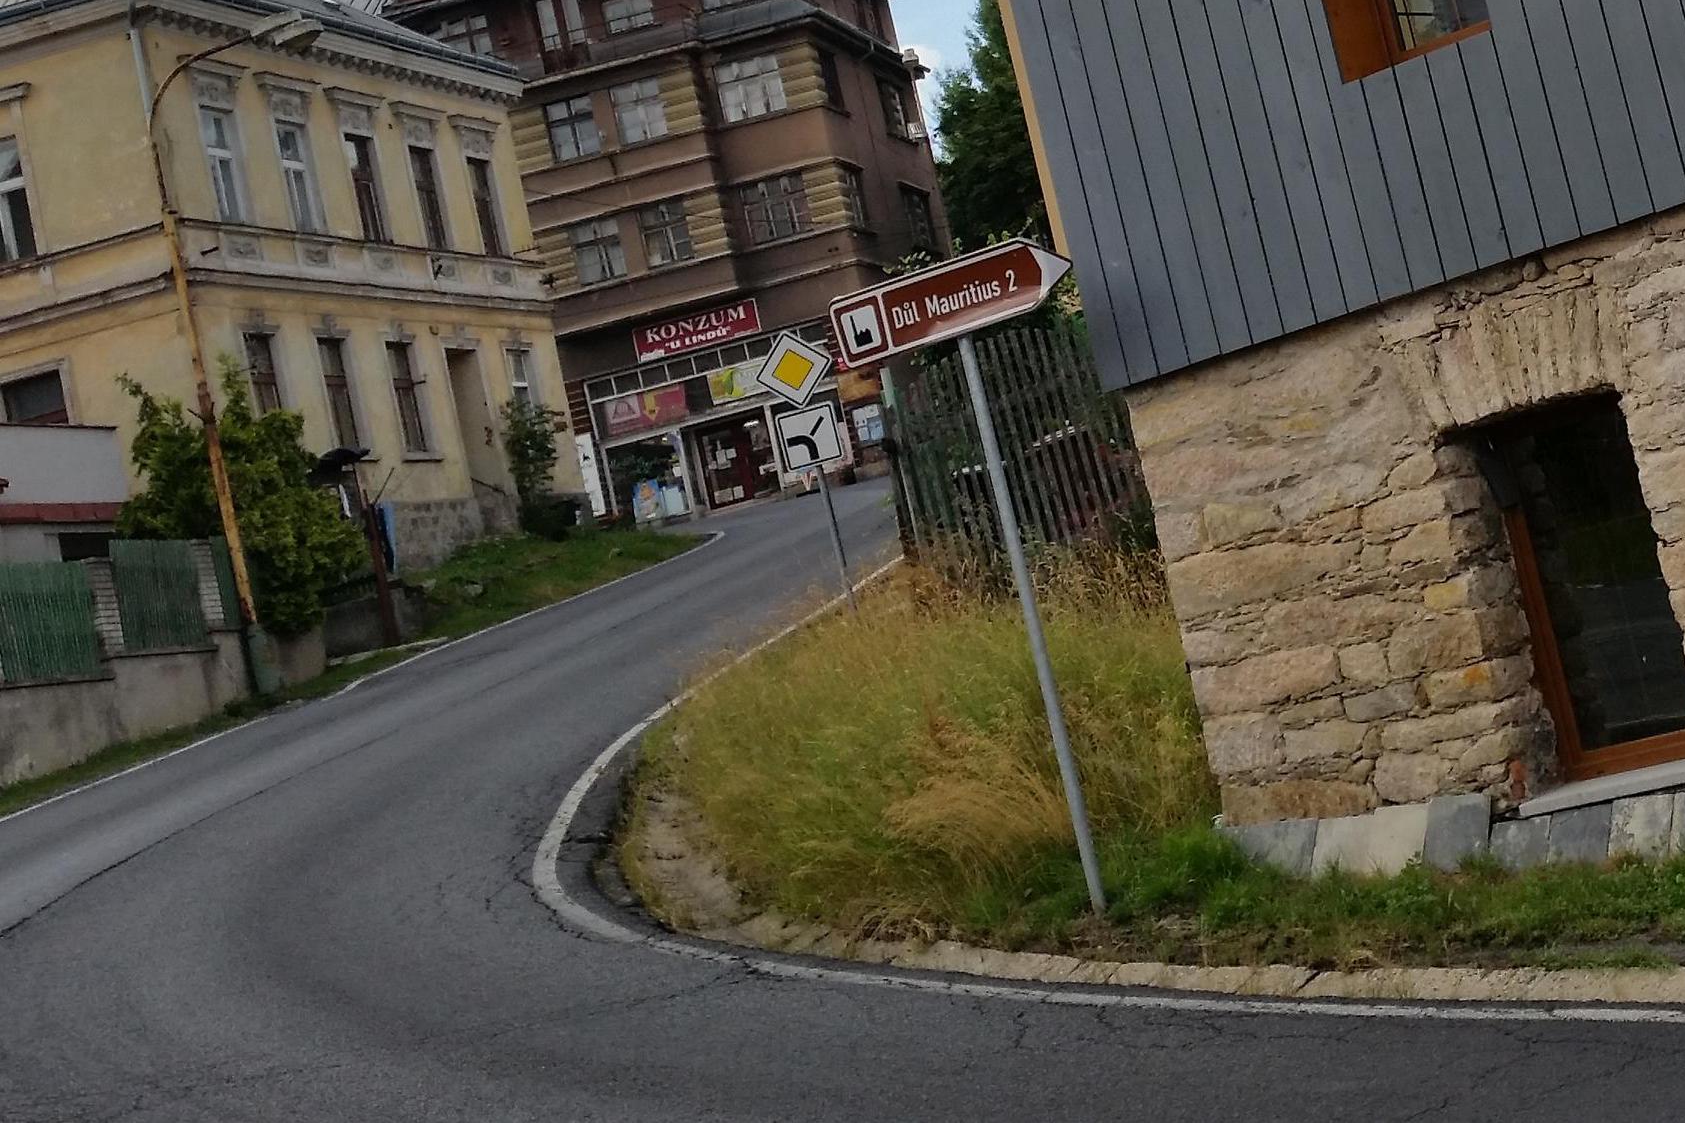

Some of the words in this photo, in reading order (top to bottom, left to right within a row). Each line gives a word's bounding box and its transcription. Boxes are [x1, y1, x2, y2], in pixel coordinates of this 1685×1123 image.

[891, 301, 920, 329] Důl
[925, 280, 1001, 318] Mauritius
[1005, 270, 1018, 292] 2
[645, 305, 747, 343] KONZUM
